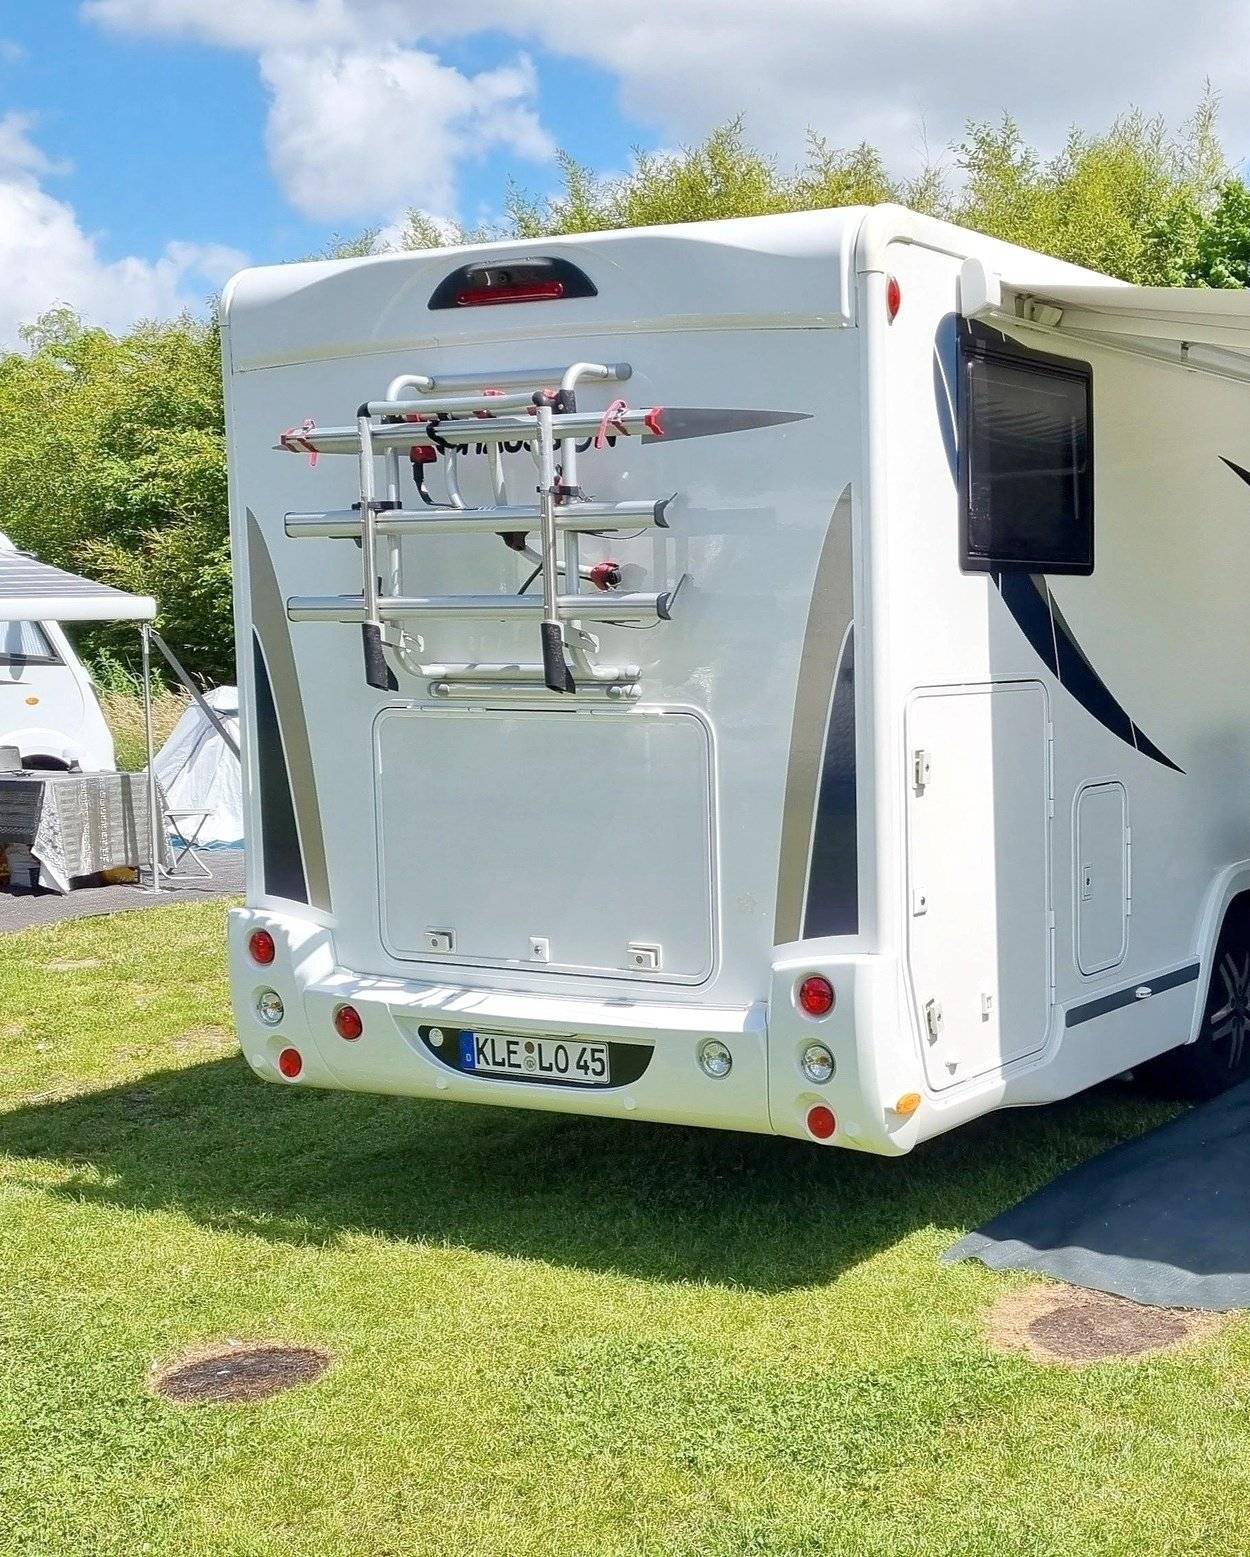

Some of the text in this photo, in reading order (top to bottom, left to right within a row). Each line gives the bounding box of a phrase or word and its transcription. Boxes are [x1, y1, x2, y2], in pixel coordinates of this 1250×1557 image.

[465, 1053, 472, 1061] D
[476, 1037, 605, 1076] KLE LO 45
